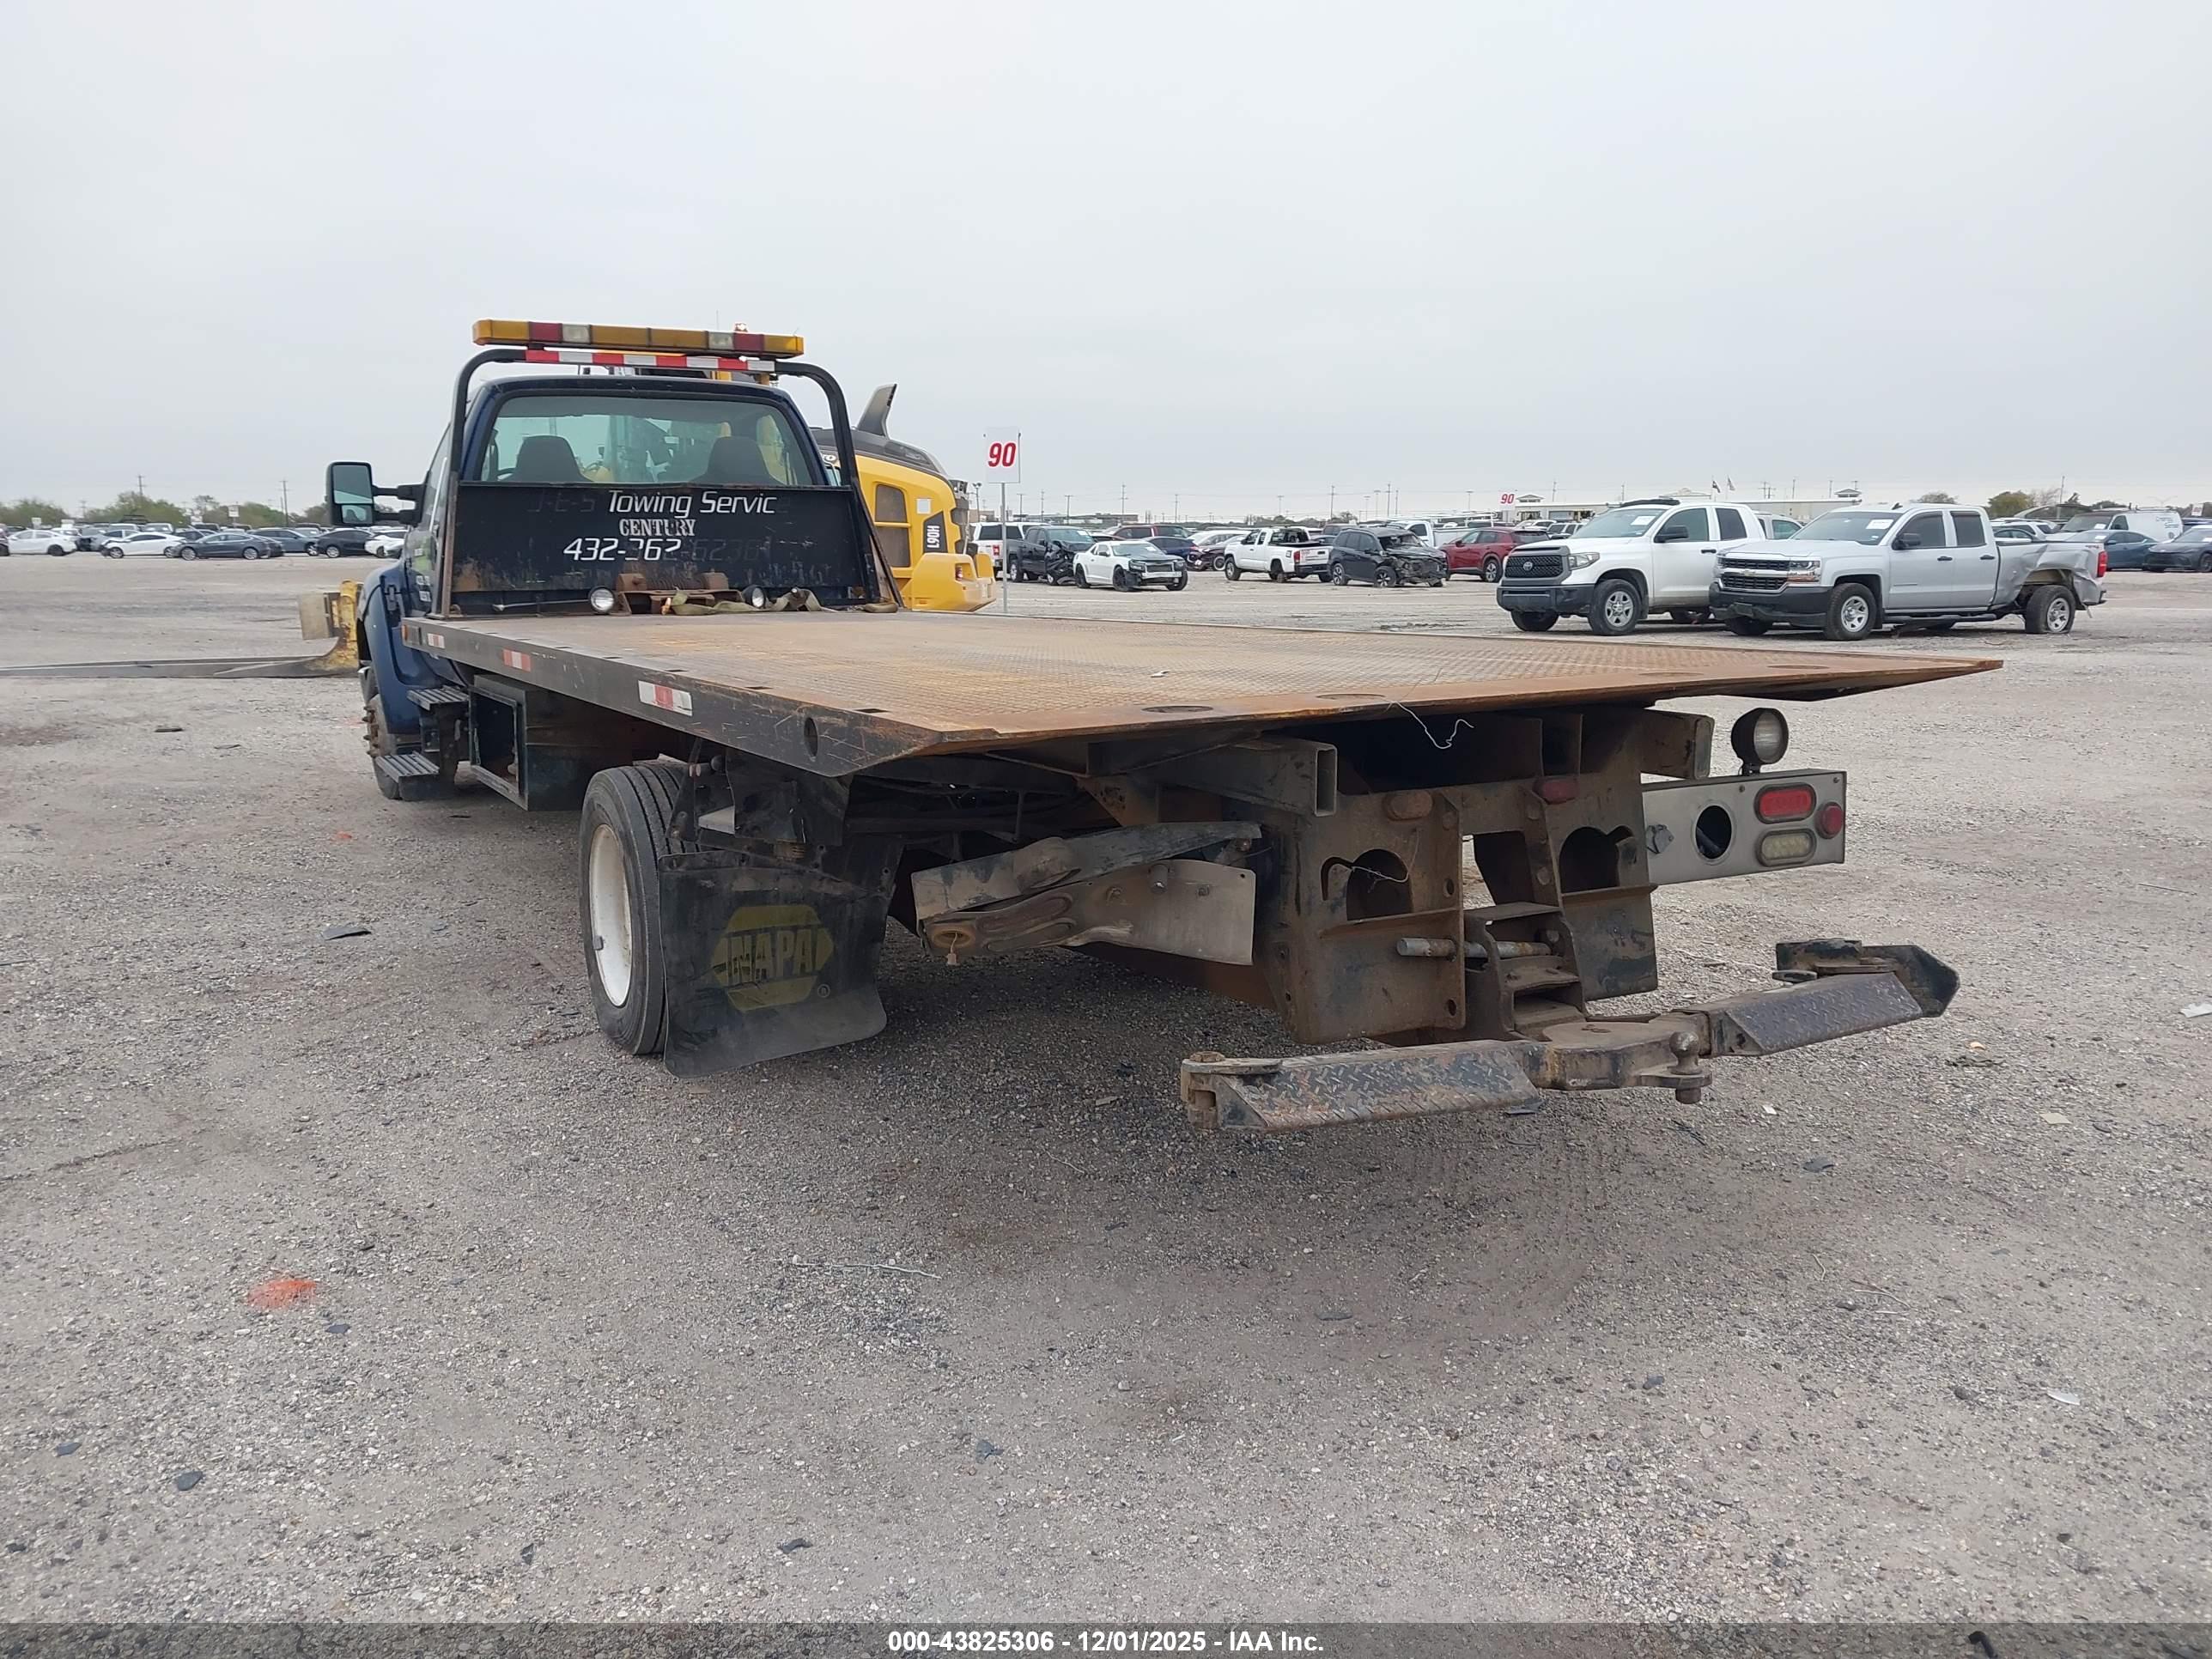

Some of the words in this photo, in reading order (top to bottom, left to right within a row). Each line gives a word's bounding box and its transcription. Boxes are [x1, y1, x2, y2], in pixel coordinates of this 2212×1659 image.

[988, 442, 1017, 467] 90
[608, 489, 692, 519] Towing
[1500, 493, 1515, 504] 90
[618, 519, 697, 537] CENTURY
[927, 525, 940, 549] L90H
[729, 928, 813, 985] NAPA
